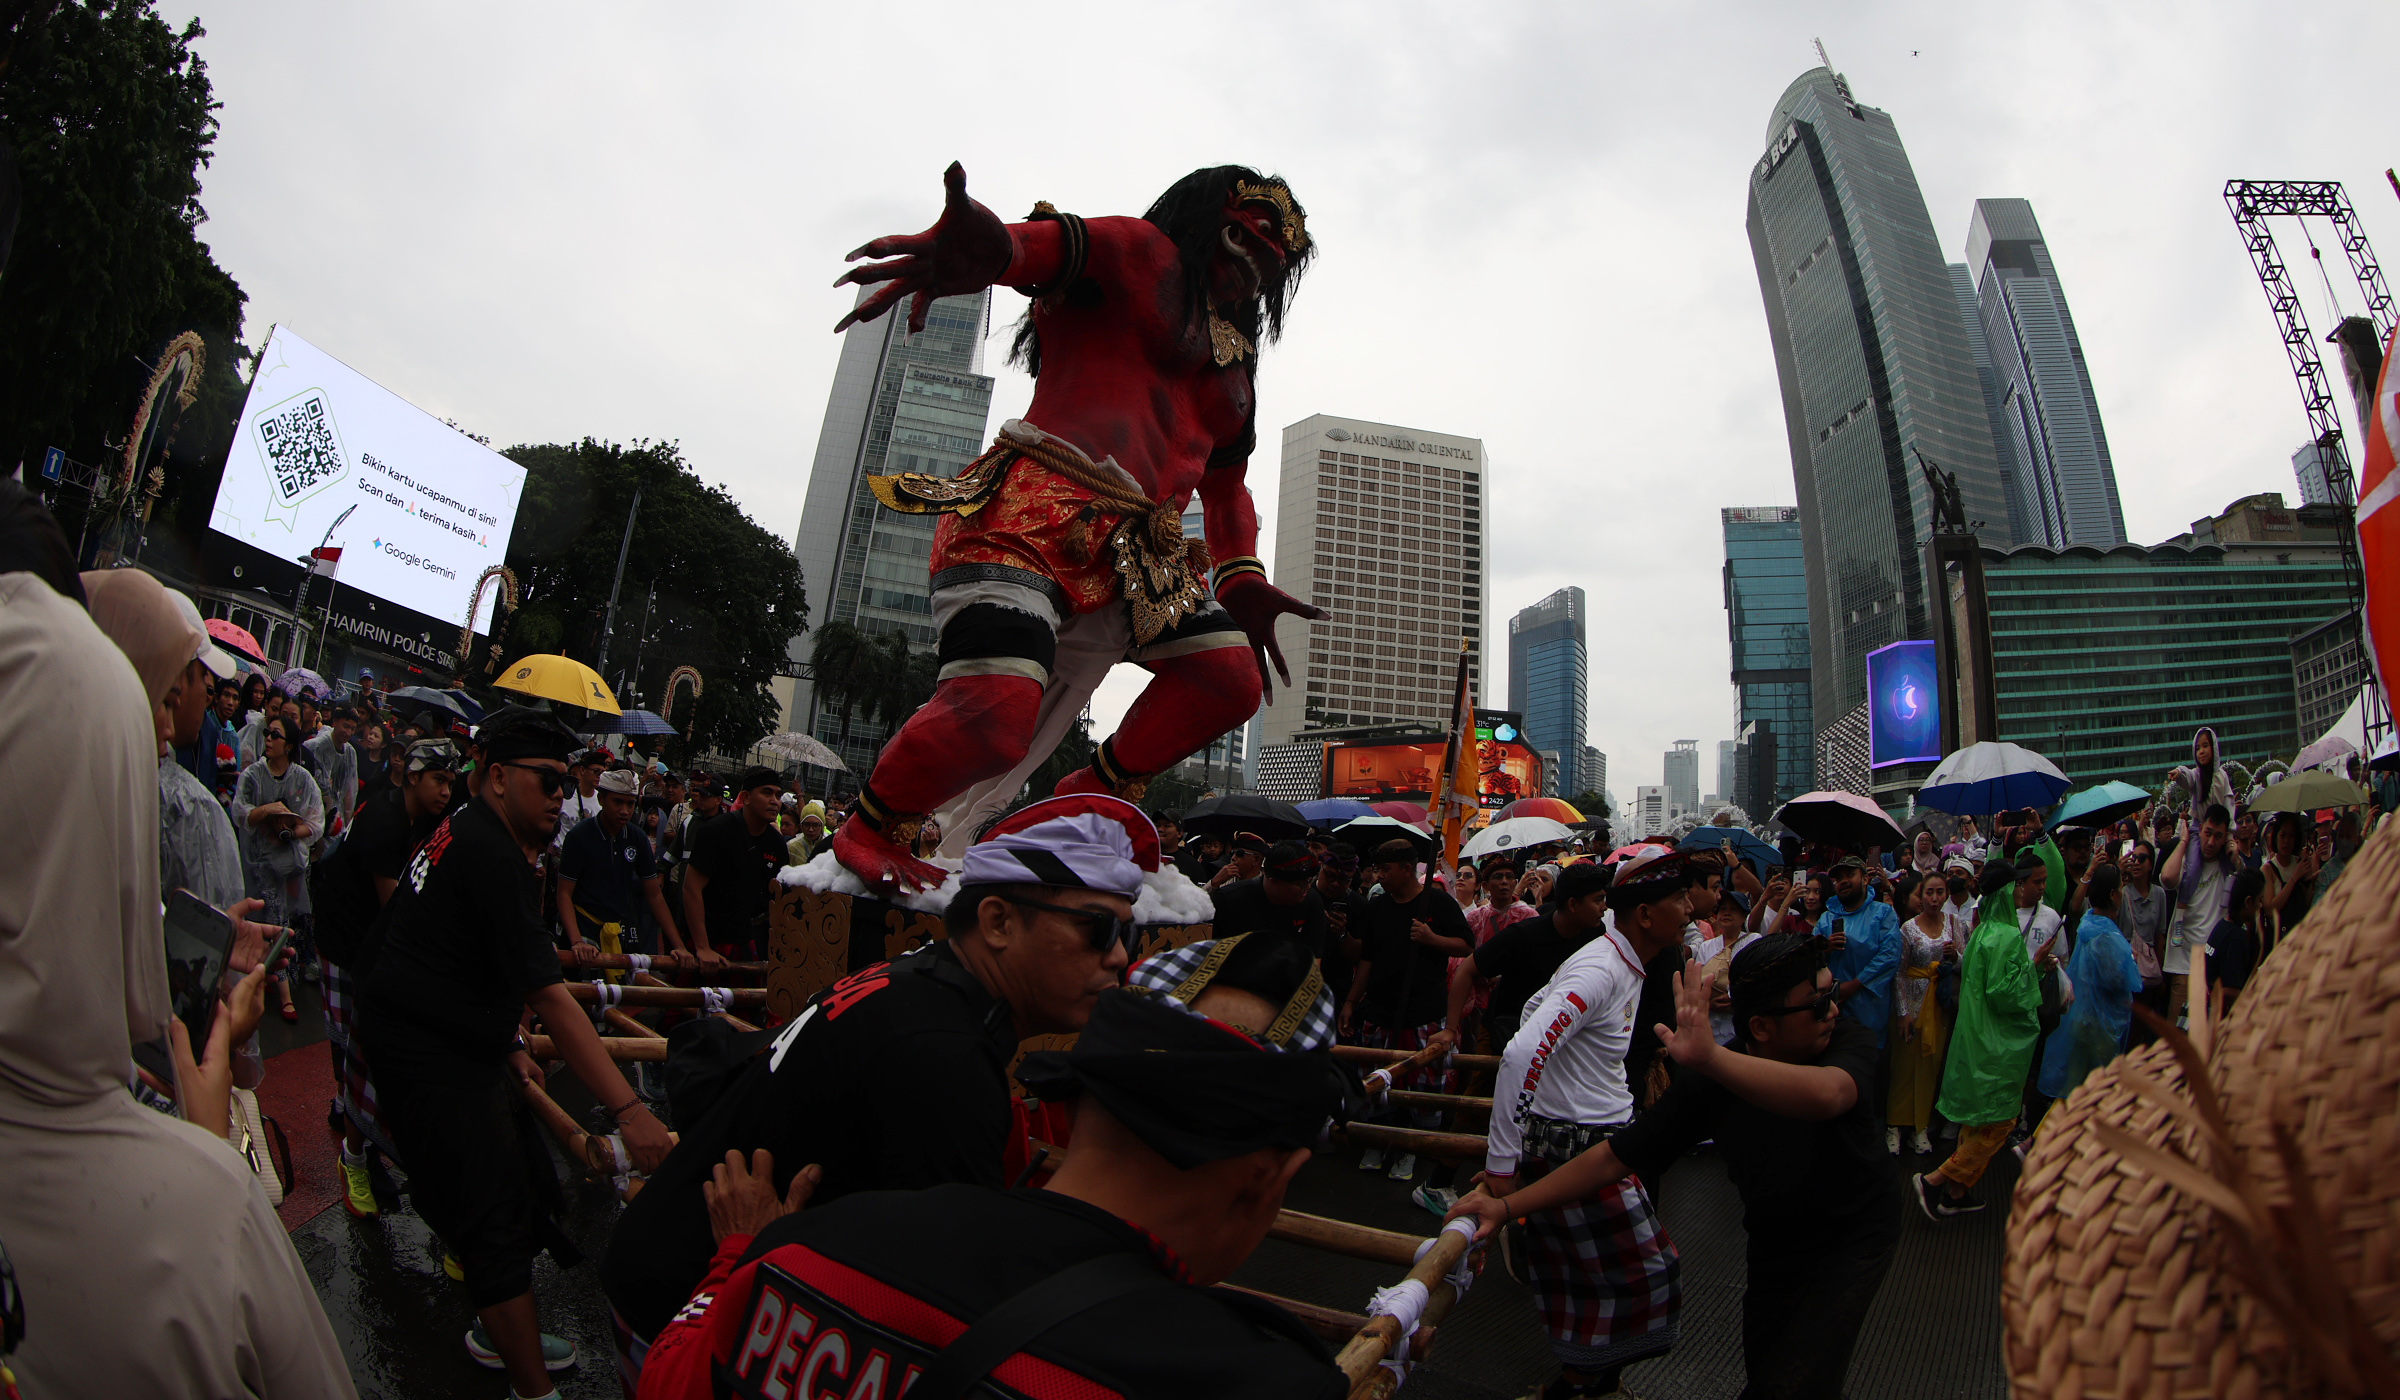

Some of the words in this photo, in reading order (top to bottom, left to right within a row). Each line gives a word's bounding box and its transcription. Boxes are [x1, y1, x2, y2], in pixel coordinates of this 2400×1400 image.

[1770, 123, 1798, 166] BCA
[914, 370, 950, 382] Deutsche
[952, 376, 973, 386] Bank
[1352, 432, 1416, 450] MANDARIN
[1418, 442, 1474, 460] ORIENTAL
[358, 478, 384, 498] Scan
[385, 492, 404, 508] dan
[419, 508, 450, 530] terima
[452, 522, 476, 542] kasih
[361, 452, 386, 474] Bikin
[388, 466, 414, 488] kartu
[416, 483, 466, 513] ucapanmu
[468, 506, 477, 518] di
[478, 511, 497, 528] sini!
[384, 542, 421, 566] Google
[422, 558, 456, 580] Gemini
[316, 606, 390, 645] THAMRIN
[392, 633, 436, 662] POLICE
[1523, 1012, 1572, 1092] PECALANG
